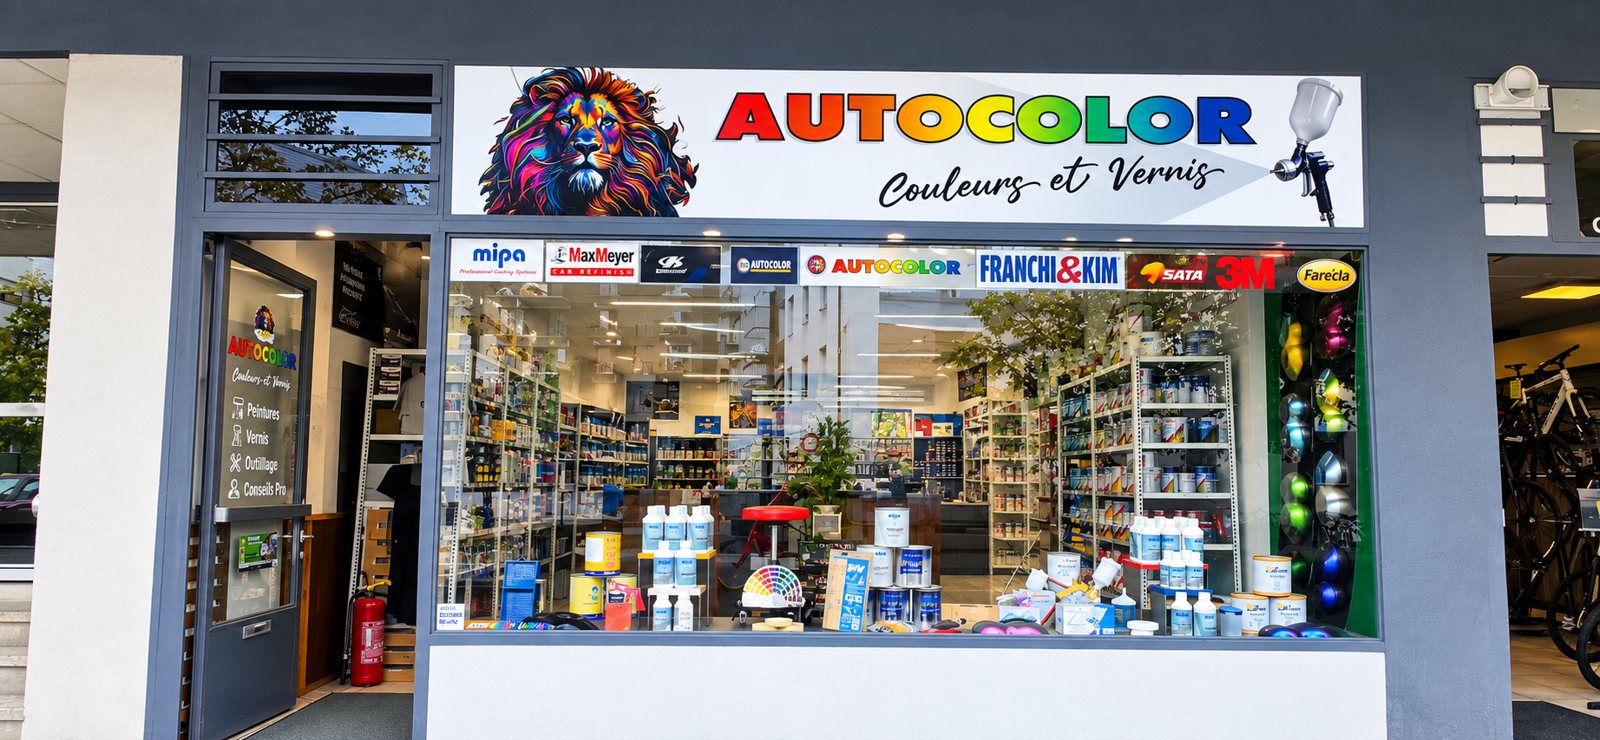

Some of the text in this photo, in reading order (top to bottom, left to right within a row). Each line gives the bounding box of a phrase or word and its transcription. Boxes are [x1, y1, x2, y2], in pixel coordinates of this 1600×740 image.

[715, 91, 1256, 146] AUTOCOLOR
[878, 155, 1226, 208] Couleurs et Vernis
[473, 242, 525, 268] mipa
[569, 247, 634, 266] MaxMeyer
[751, 260, 791, 269] AUTOCOLOR
[831, 258, 961, 275] AUTOCOLOR
[980, 254, 1119, 284] FRANCHI&KIM
[1161, 269, 1203, 281] SATA
[1215, 256, 1275, 290] 3M
[228, 335, 296, 371] AUTOCOLOR
[232, 367, 291, 391] Couleurs et Vernis
[247, 402, 280, 421] Peintures
[246, 429, 269, 445] Vernis
[243, 481, 287, 497] Conseils Pro
